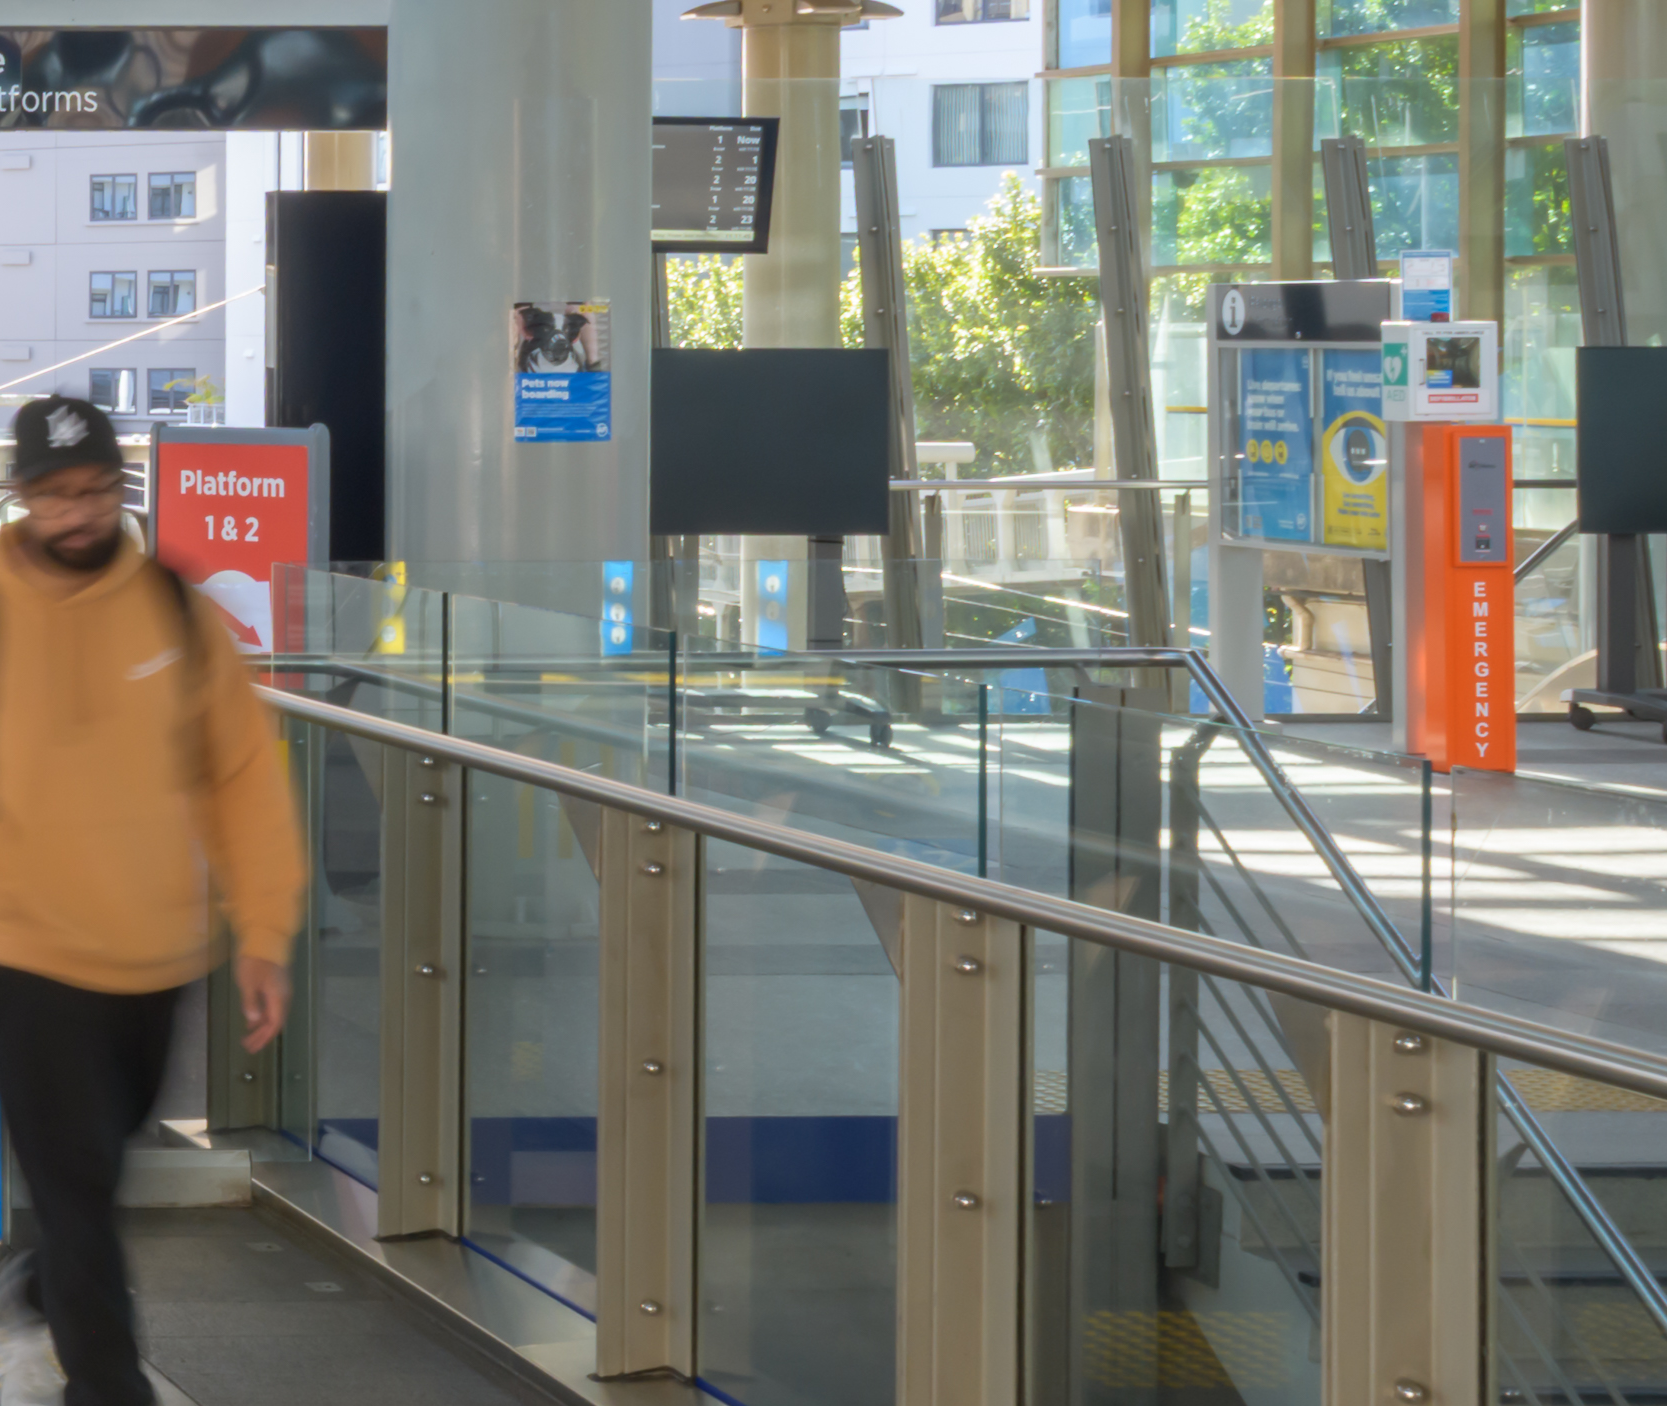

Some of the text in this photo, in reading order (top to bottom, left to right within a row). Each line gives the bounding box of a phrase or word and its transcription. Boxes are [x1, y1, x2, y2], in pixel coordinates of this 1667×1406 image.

[737, 136, 761, 144] Now
[715, 155, 722, 164] 2
[713, 175, 757, 184] 2 20
[742, 195, 755, 204] 20
[709, 215, 753, 224] 2 23
[522, 379, 569, 388] Pets now
[522, 389, 569, 400] boarding
[180, 469, 285, 498] Platform
[204, 515, 259, 542] 1 & 2
[1473, 582, 1489, 757] EMERGENCY
